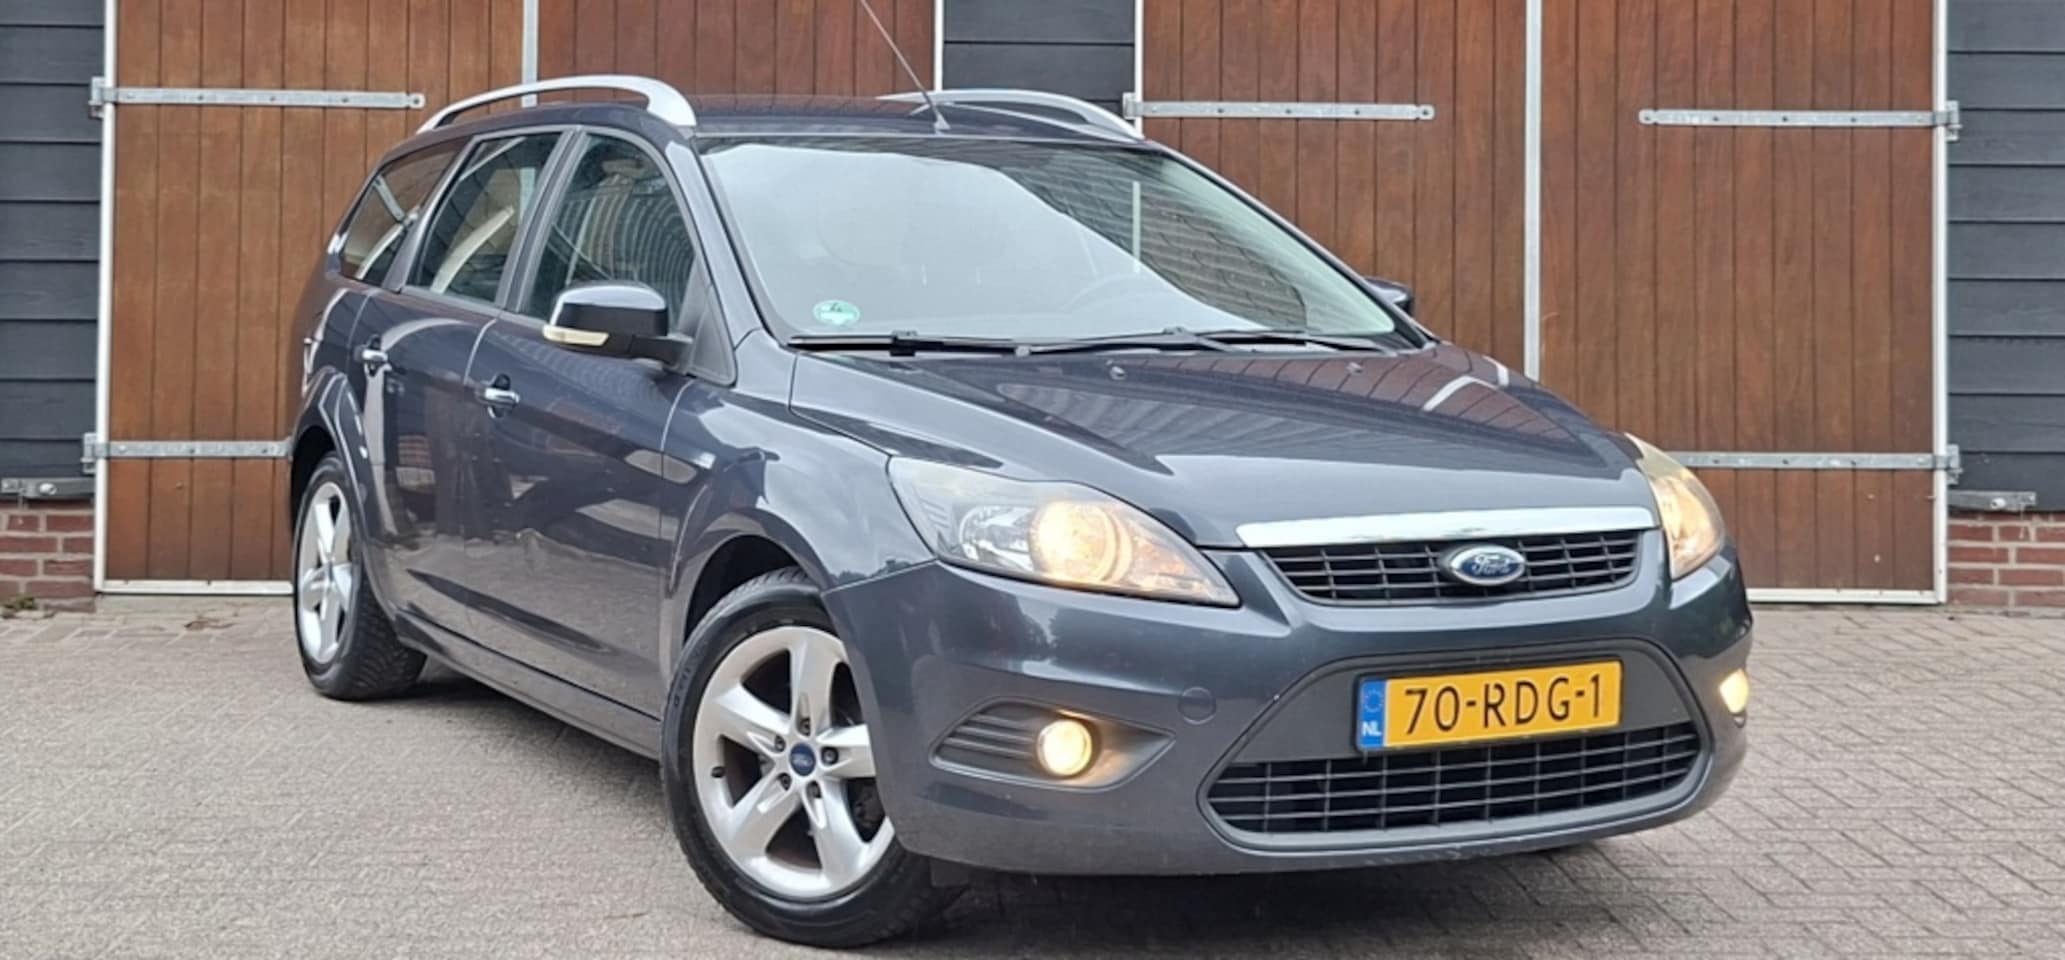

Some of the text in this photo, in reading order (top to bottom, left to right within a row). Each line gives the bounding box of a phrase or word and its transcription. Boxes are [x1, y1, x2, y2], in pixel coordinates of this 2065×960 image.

[1471, 554, 1511, 575] Ford
[1404, 673, 1600, 735] 70-RDG-1
[1362, 721, 1382, 736] NL
